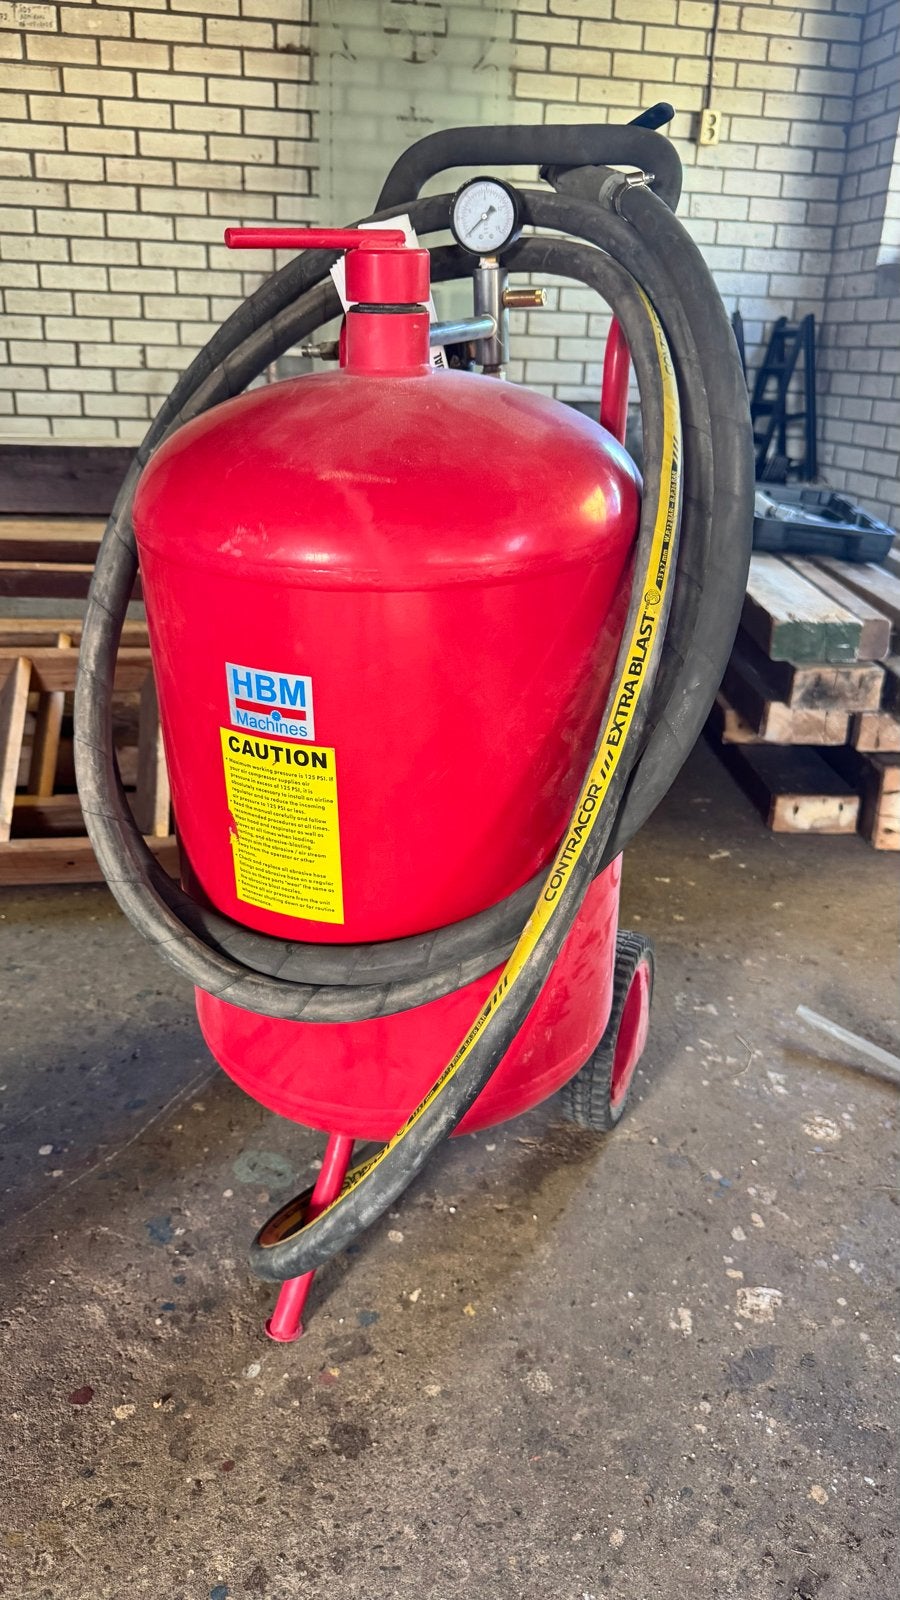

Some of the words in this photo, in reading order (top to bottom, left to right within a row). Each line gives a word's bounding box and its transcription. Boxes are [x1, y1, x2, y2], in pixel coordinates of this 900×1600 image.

[657, 572, 664, 581] 13
[661, 548, 668, 562] mm
[232, 668, 306, 708] HBM
[606, 680, 638, 747] EXTRA
[630, 614, 656, 676] BLAST
[236, 710, 308, 738] Machines
[228, 736, 328, 769] CAUTION
